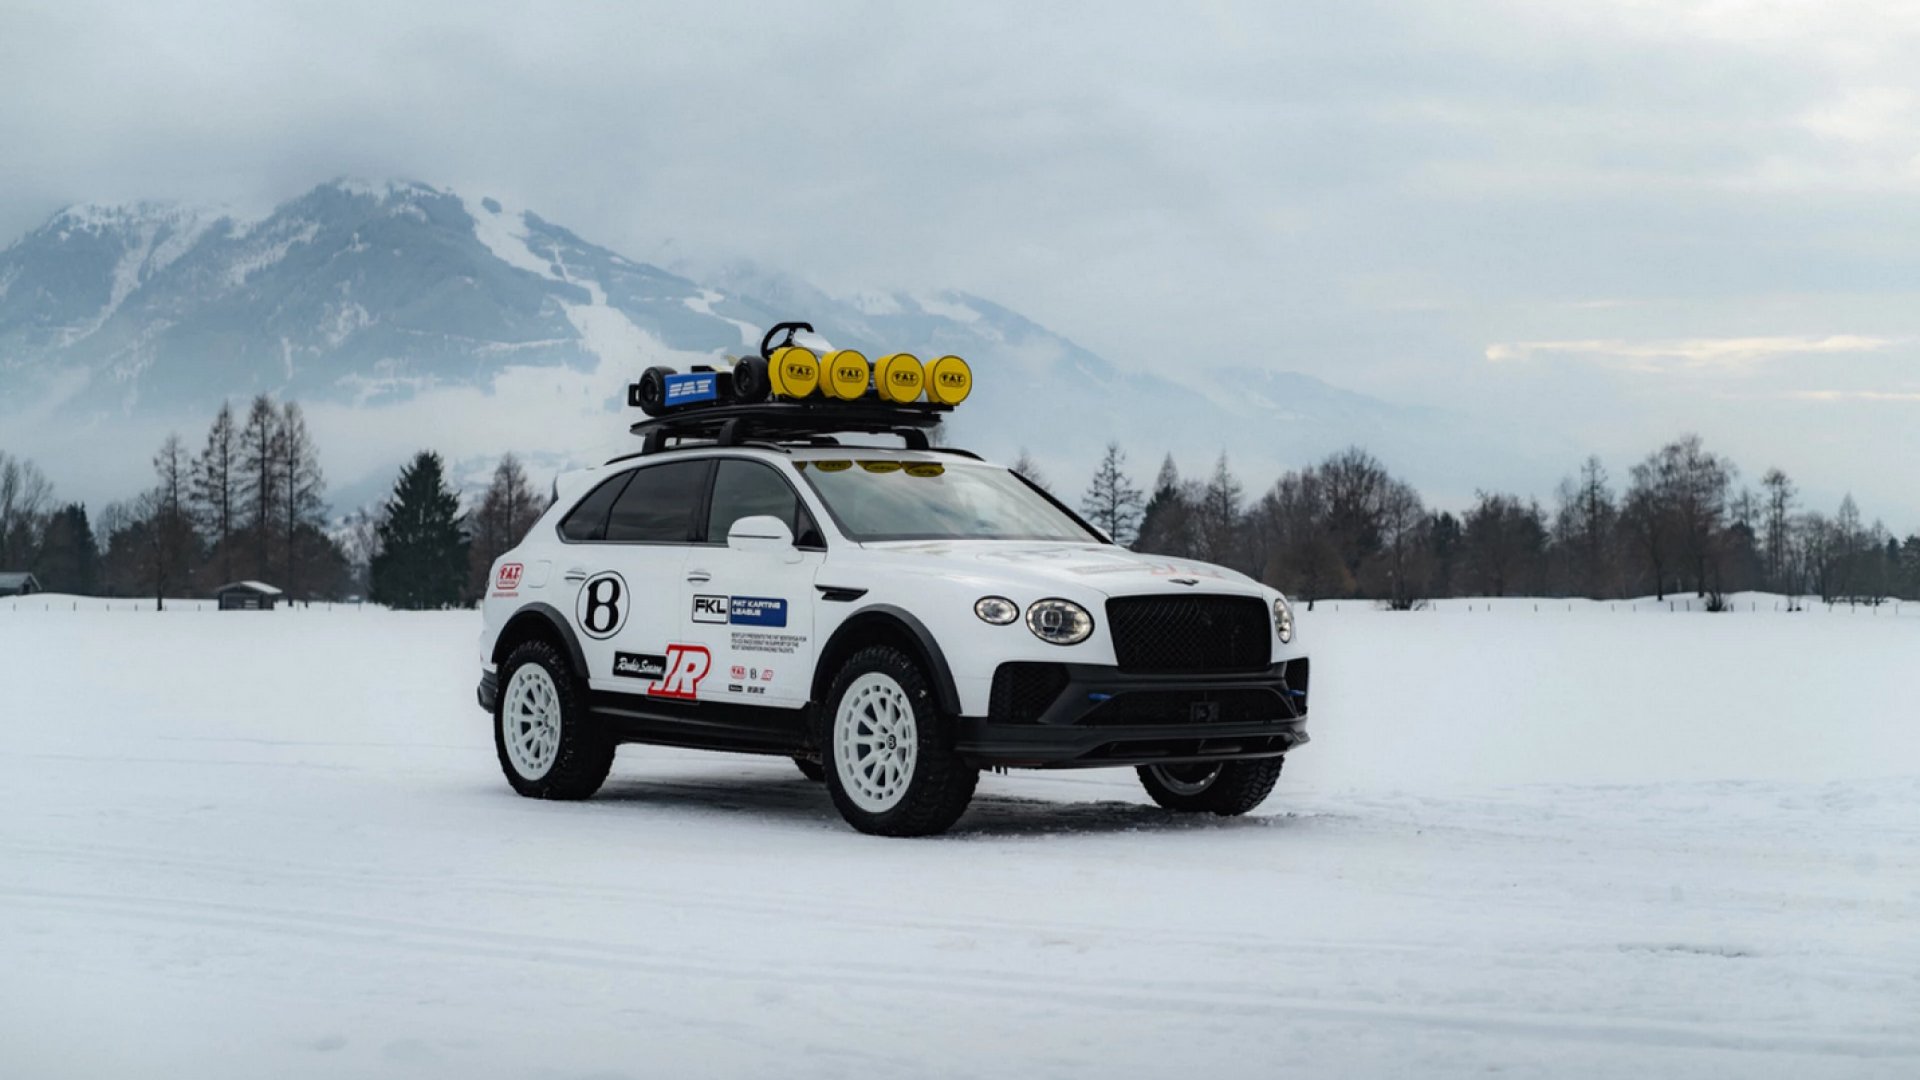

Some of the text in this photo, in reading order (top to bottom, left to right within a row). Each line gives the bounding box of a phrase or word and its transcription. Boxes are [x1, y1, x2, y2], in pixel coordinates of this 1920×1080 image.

[584, 577, 621, 633] 8
[695, 599, 727, 614] FKL
[732, 607, 762, 616] LEAGUE
